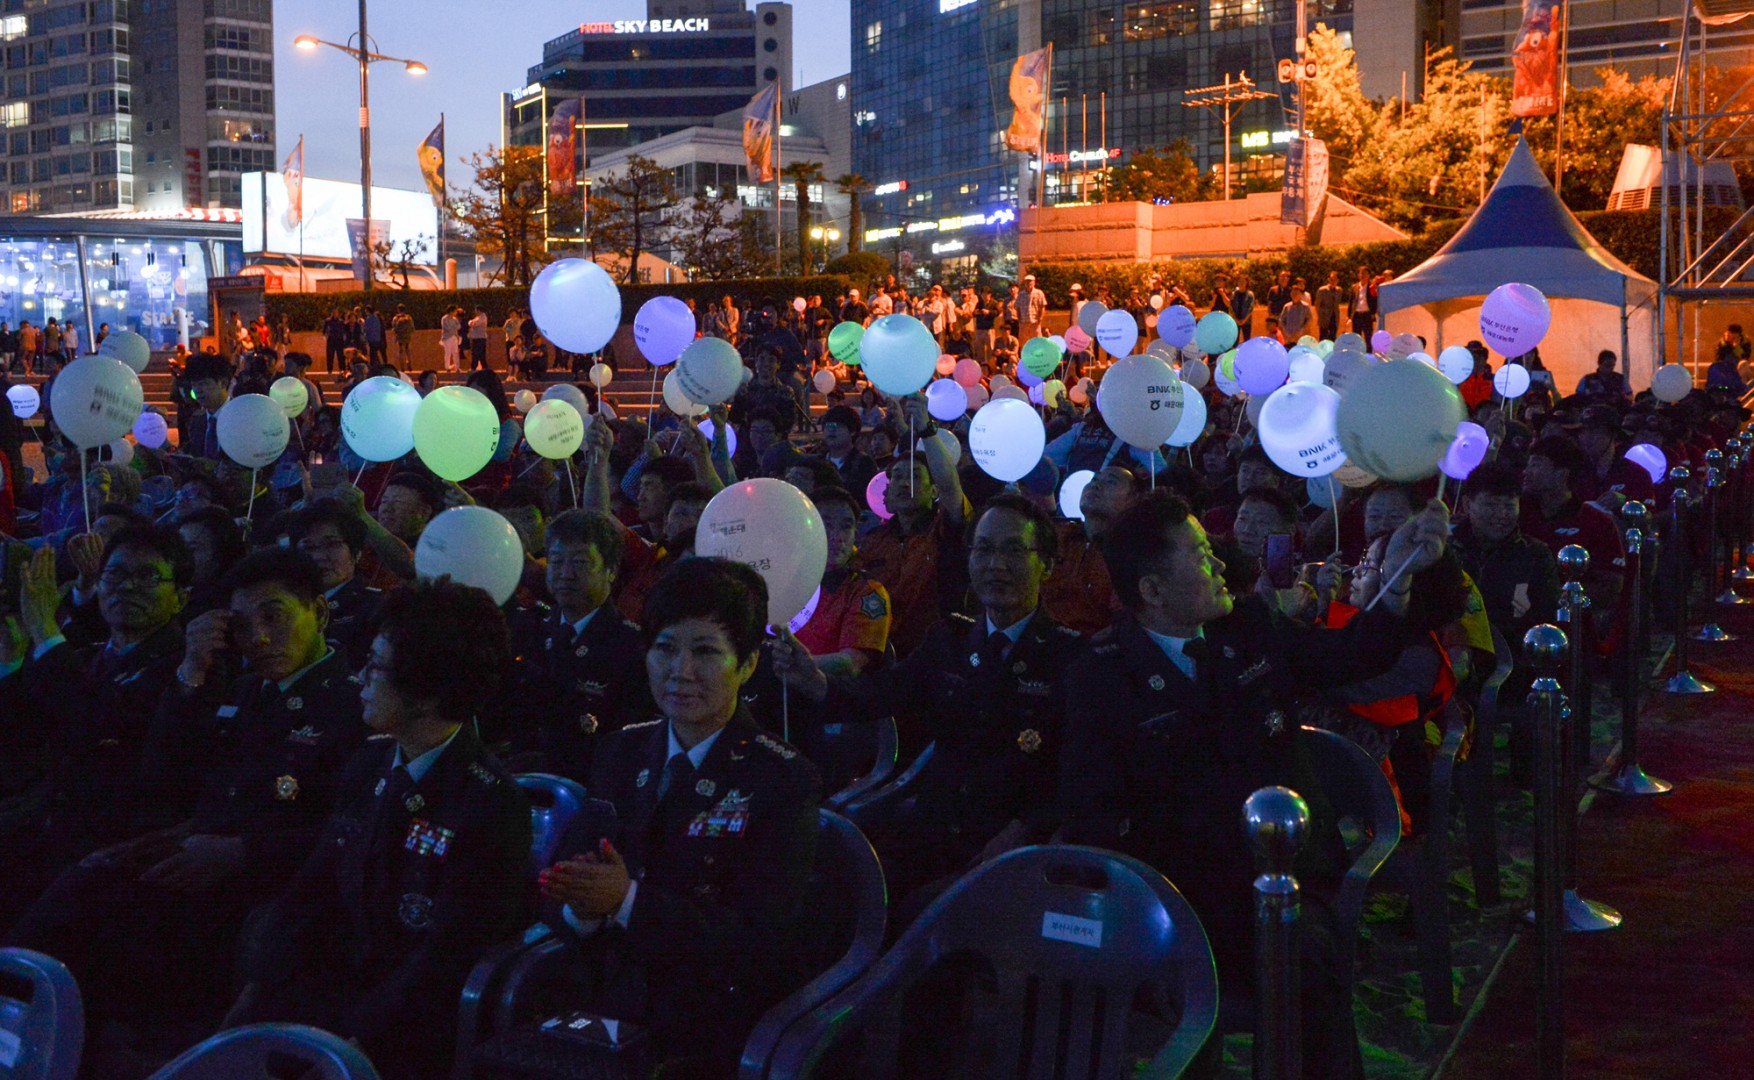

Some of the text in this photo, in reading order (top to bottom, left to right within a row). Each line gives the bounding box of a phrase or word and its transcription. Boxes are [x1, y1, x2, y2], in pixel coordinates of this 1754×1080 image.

[580, 18, 709, 34] HOTEL SKY BEACH
[1147, 385, 1171, 394] BNK
